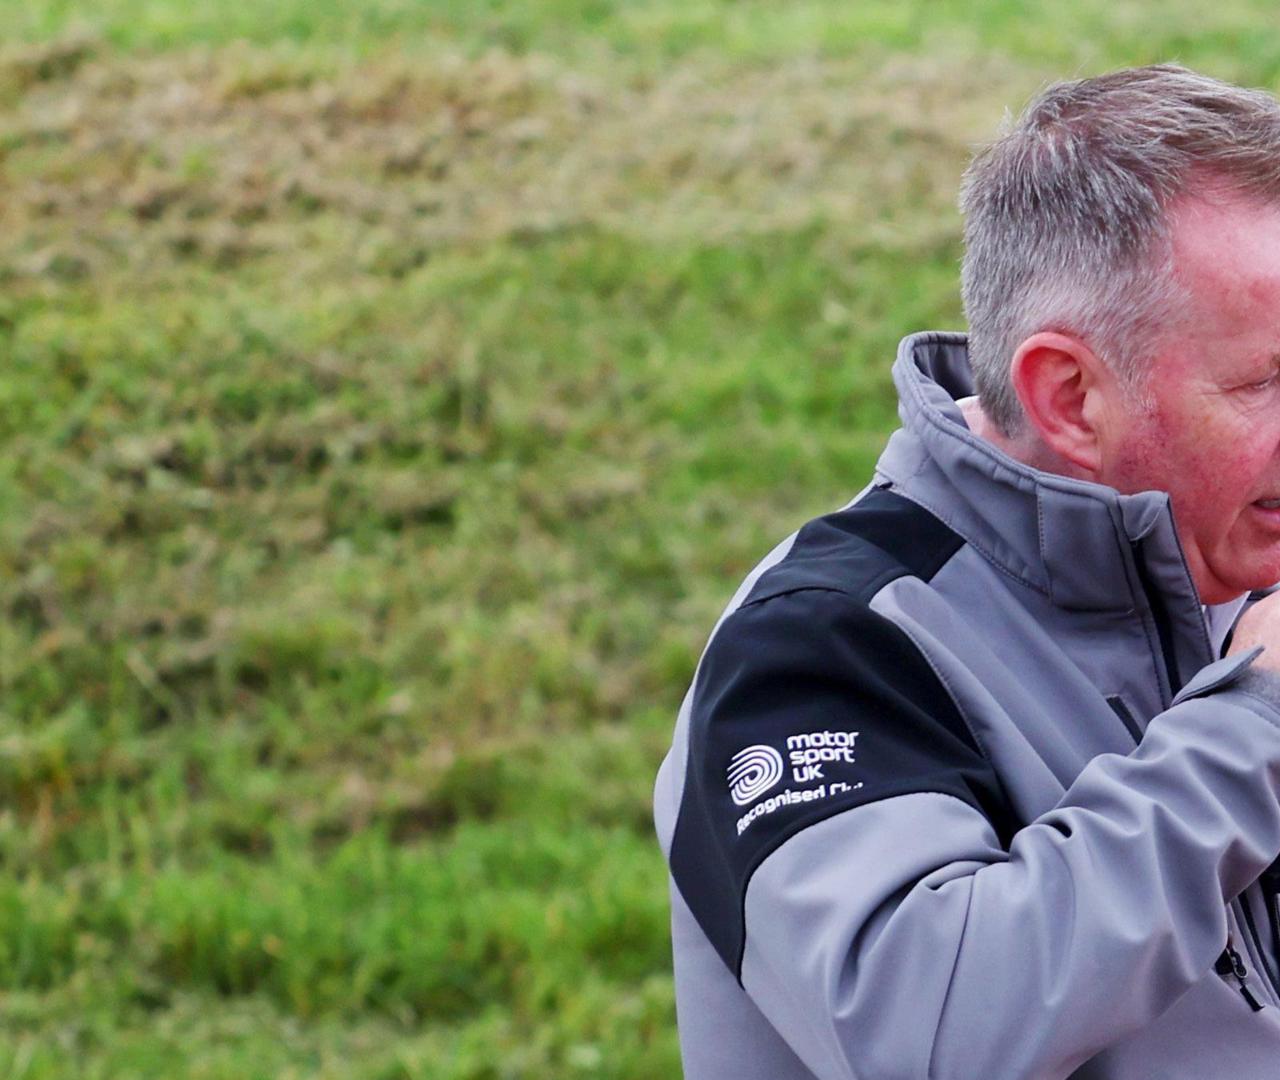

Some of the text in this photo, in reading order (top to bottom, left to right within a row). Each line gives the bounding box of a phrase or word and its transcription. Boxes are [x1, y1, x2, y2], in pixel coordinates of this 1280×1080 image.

[786, 731, 859, 749] motor
[789, 747, 855, 765] sport
[792, 764, 824, 782] UK
